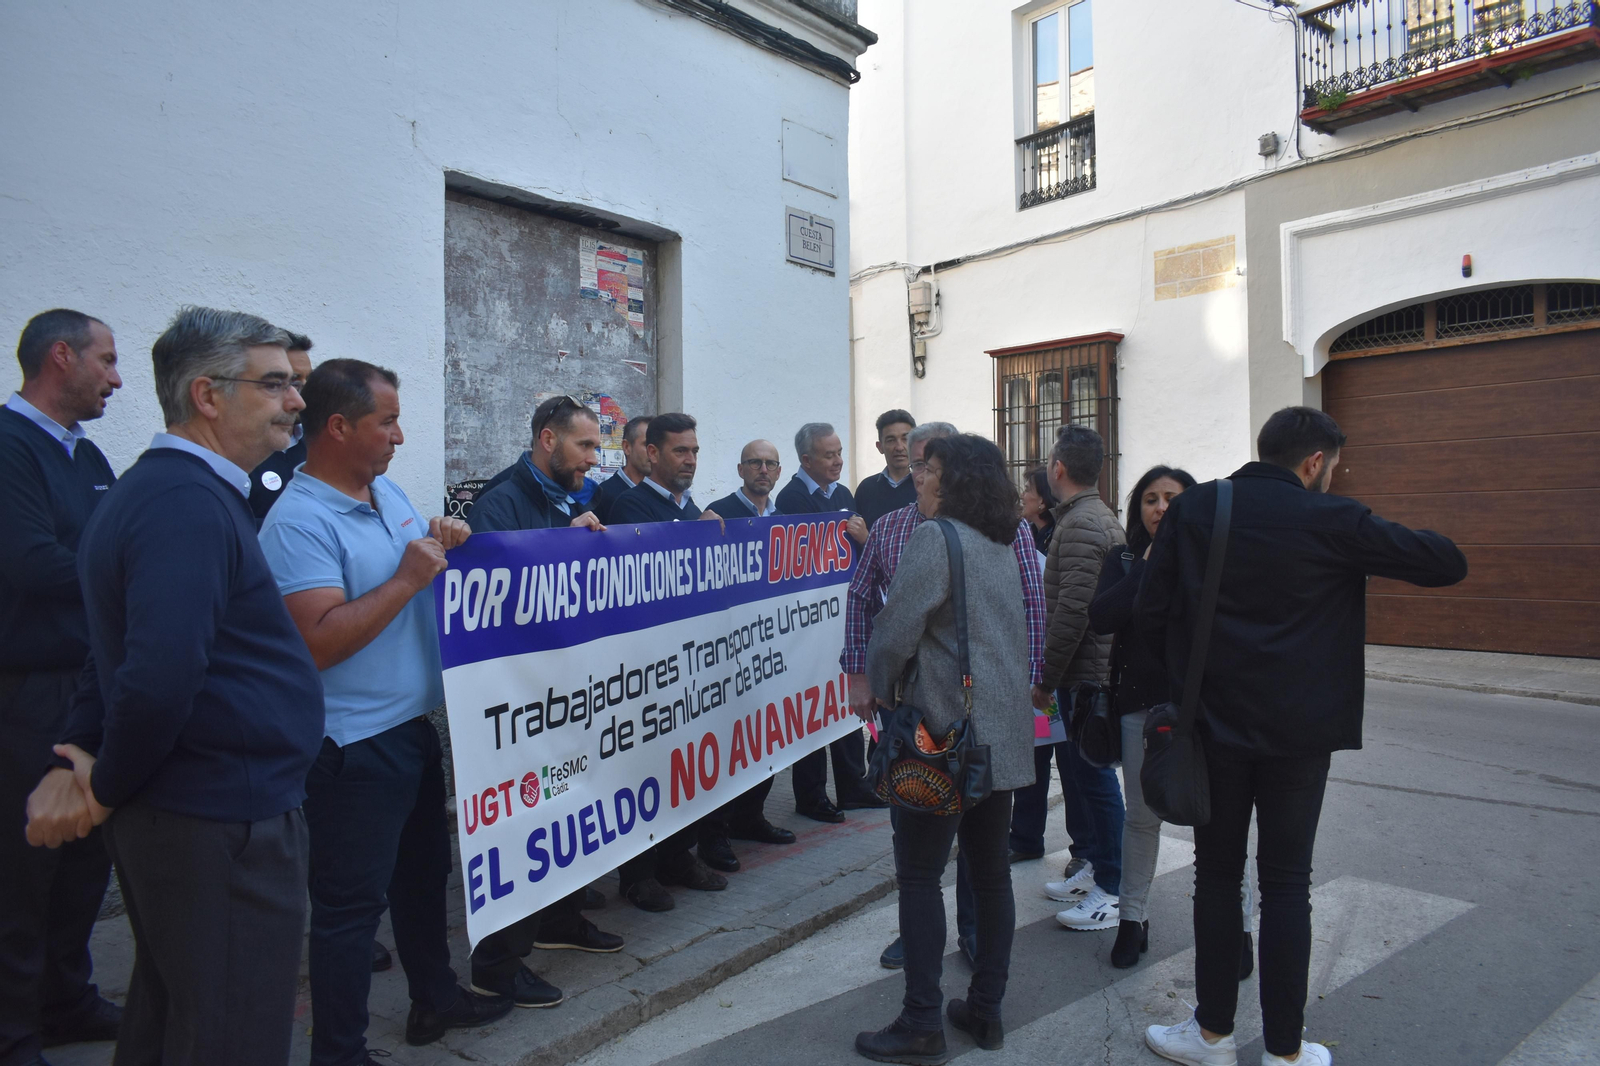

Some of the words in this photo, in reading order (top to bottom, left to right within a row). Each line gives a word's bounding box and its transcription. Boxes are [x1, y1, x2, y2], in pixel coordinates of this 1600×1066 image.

[800, 226, 823, 241] CUESTA
[444, 567, 512, 635] POR
[514, 560, 581, 626] UNAS
[586, 548, 693, 614] CONDICIONES
[696, 540, 763, 593] LABRALES
[768, 520, 852, 584] DIGNAS
[484, 654, 680, 750] Trabajadores
[682, 614, 774, 676] Transporte
[777, 596, 840, 635] Urbano
[599, 715, 634, 760] de
[642, 676, 732, 744] Sanlúcar
[735, 660, 751, 697] de
[751, 646, 788, 686] Bda.
[463, 778, 515, 835] UGT
[550, 754, 588, 785] FeSMC
[467, 846, 515, 915] EL
[526, 776, 661, 883] SUELDO
[670, 731, 720, 810] NO
[551, 781, 570, 797] Cádiz
